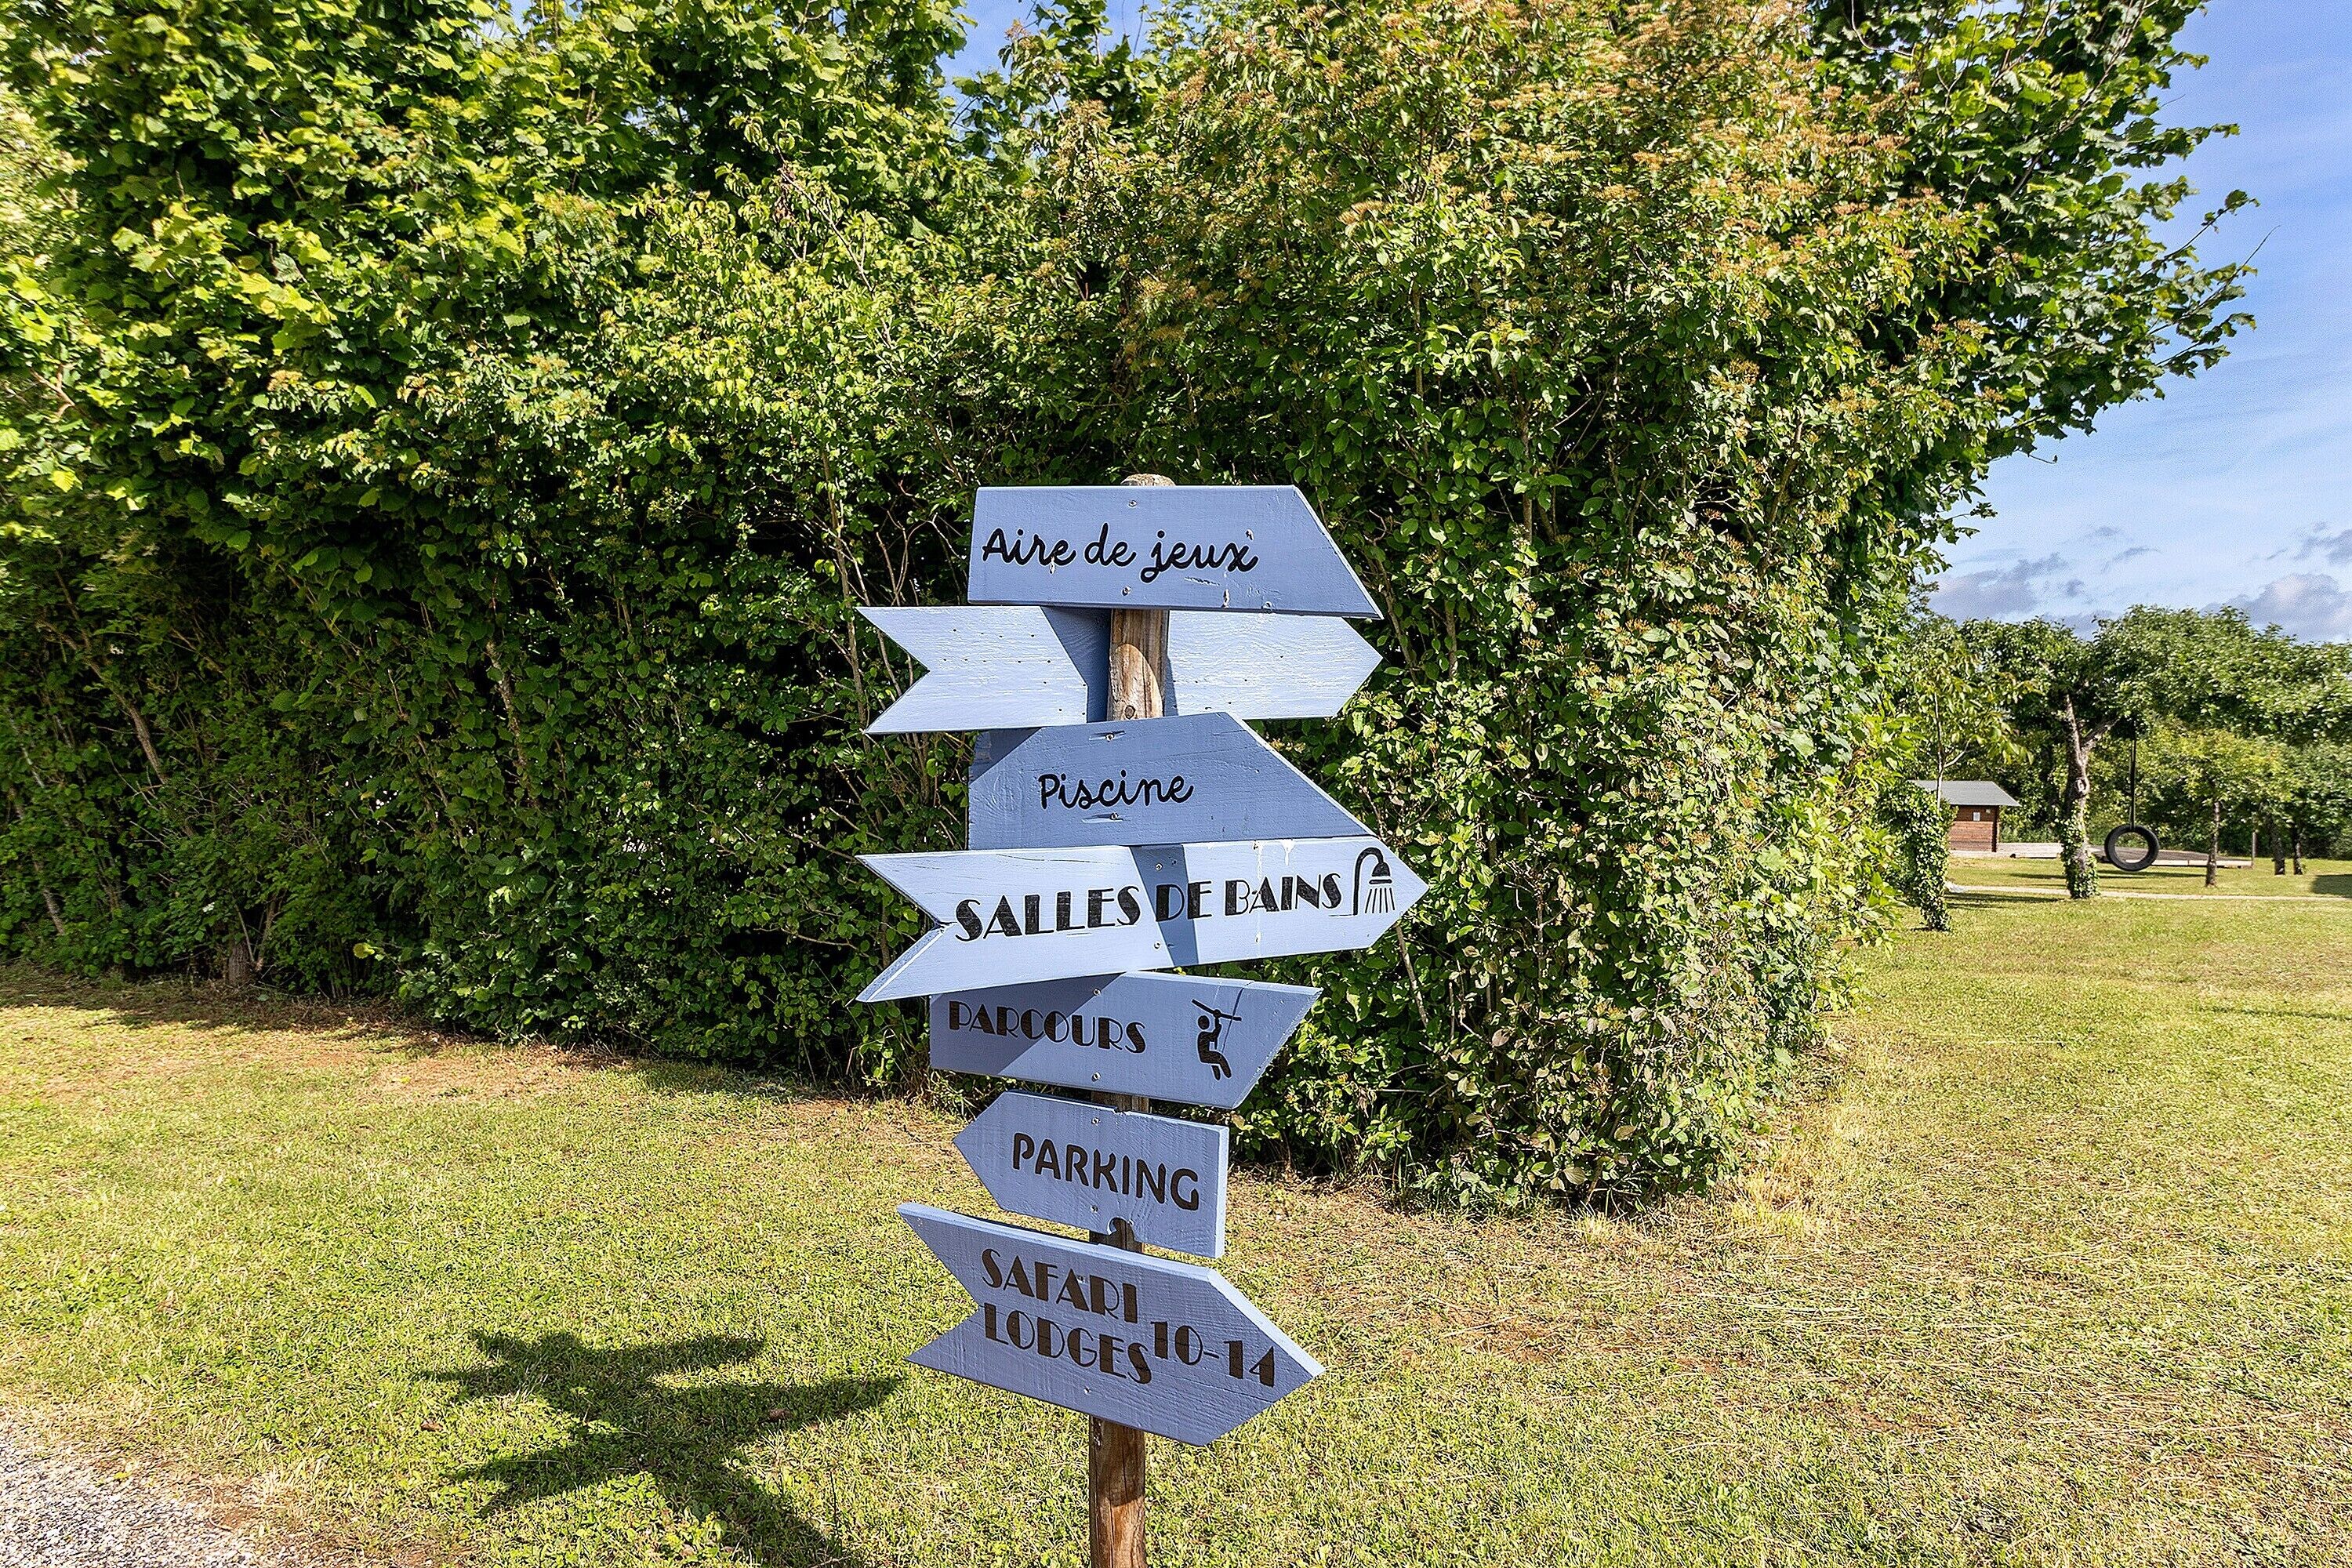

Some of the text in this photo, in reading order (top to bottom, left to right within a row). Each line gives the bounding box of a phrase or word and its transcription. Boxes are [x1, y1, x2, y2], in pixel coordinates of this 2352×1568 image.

[982, 522, 1259, 583] Aire de jeux
[1037, 769, 1194, 810] Piscine
[955, 872, 1342, 942] SALLES DE BAINS
[947, 1000, 1146, 1054] PARCOURS
[1012, 1132, 1200, 1211] PARKING
[981, 1248, 1138, 1324] SAFARI
[983, 1302, 1275, 1388] LODGES 10-14
